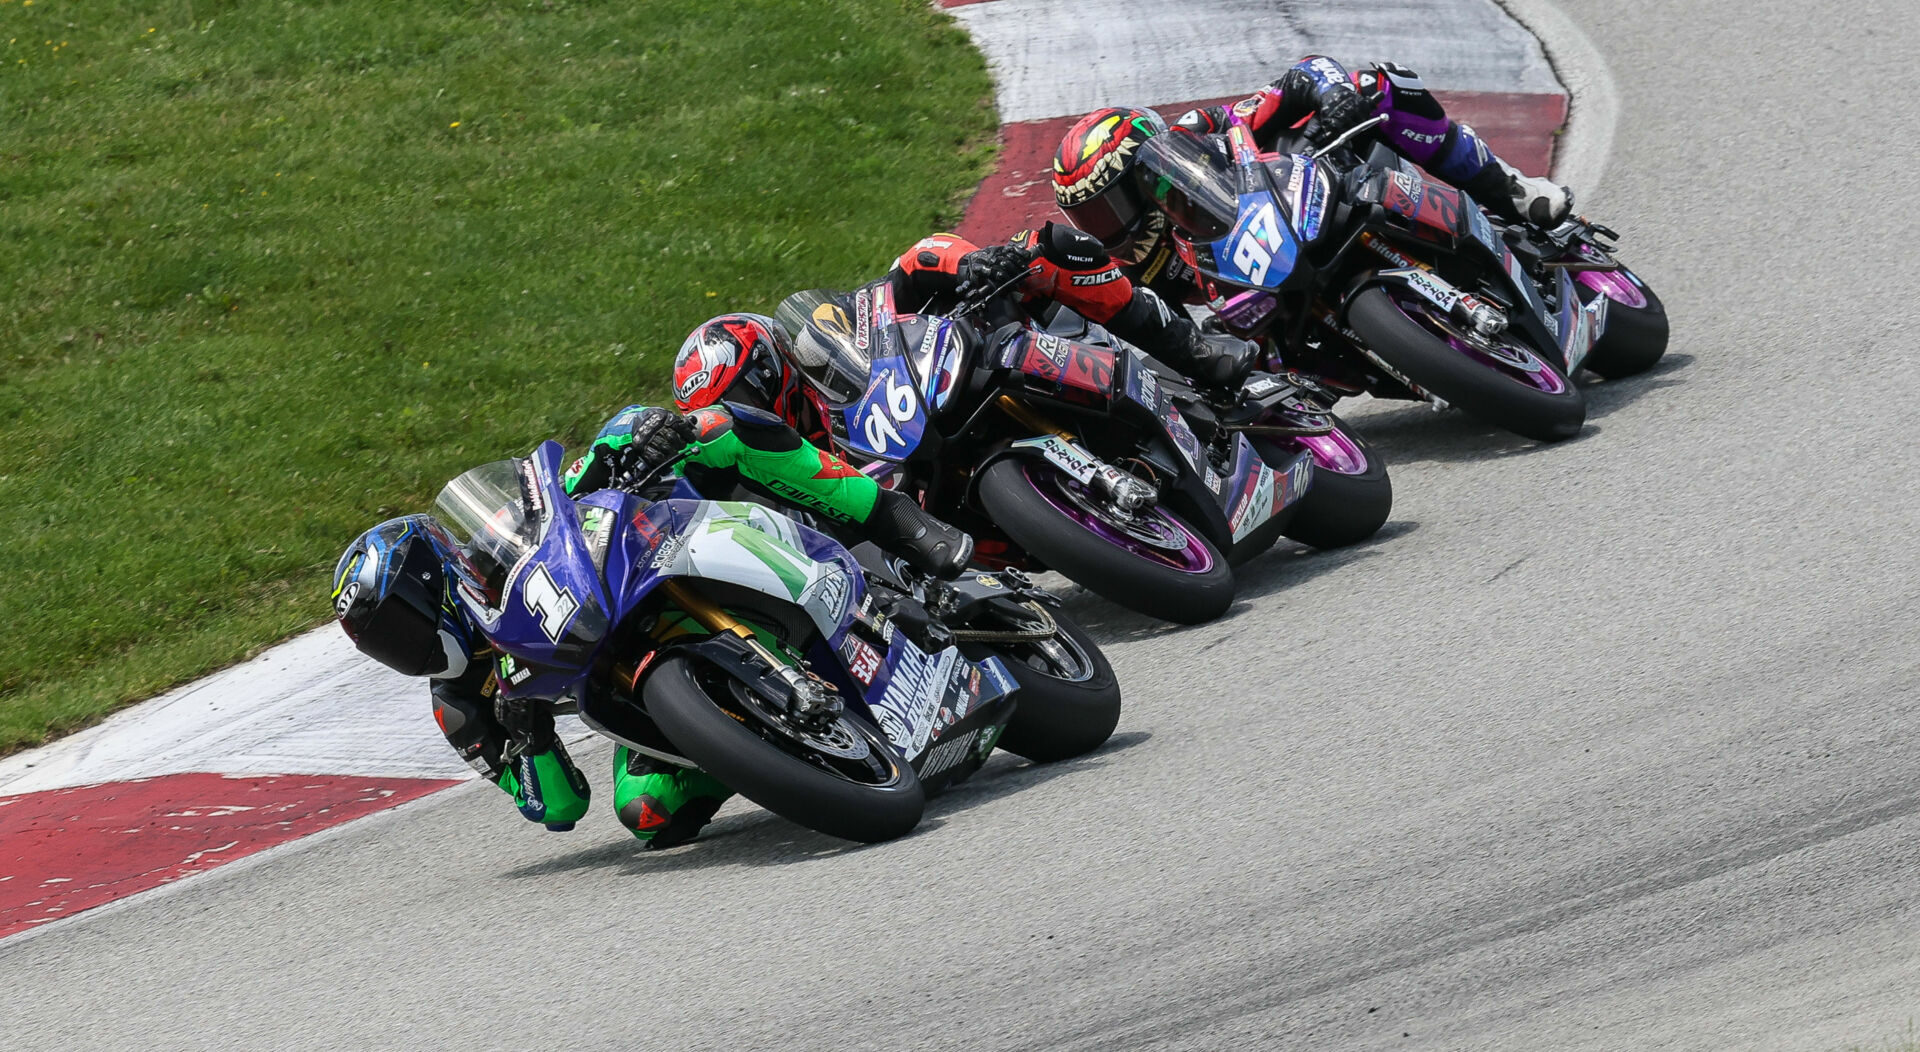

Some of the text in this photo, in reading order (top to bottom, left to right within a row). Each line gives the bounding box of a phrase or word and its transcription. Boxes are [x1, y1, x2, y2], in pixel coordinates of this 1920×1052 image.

[1067, 254, 1093, 263] TAICHI
[1232, 201, 1284, 287] 97
[1072, 267, 1123, 285] TAICHI
[681, 371, 708, 399] HJC
[864, 368, 917, 454] 96
[1043, 439, 1088, 477] DUNLOP
[767, 480, 852, 523] DAINESE
[1231, 493, 1248, 530] DUNLOP
[523, 561, 581, 646] 1
[556, 598, 573, 619] 22
[500, 652, 515, 679] N2
[880, 638, 928, 720] YAMAHA
[906, 654, 936, 727] DUNLOP
[879, 709, 904, 743] STM
